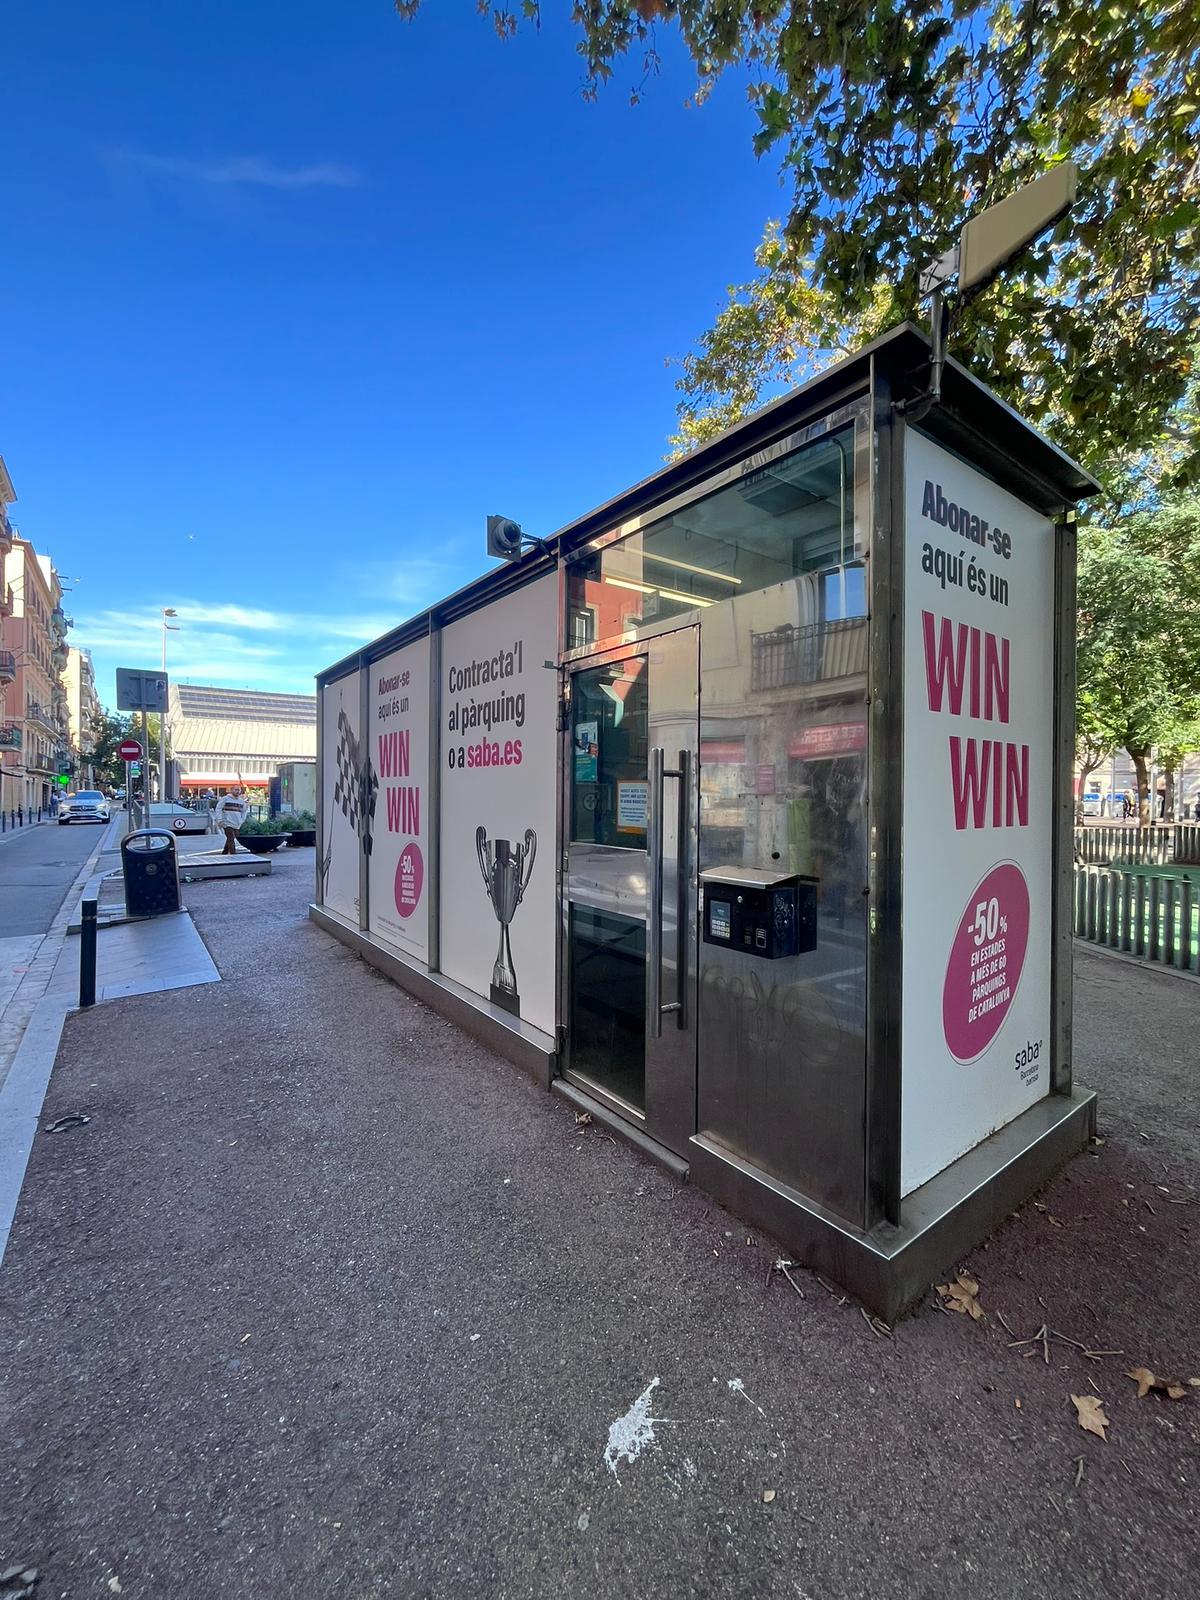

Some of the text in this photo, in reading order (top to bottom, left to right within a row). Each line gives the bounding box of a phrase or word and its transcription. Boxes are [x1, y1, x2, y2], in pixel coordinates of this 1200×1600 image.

[922, 479, 1012, 560] Abonar-se
[921, 542, 1009, 607] aquí és un
[378, 670, 410, 696] Abonar-se
[449, 639, 523, 694] Contracta'l
[921, 609, 1010, 724] WIN
[378, 696, 409, 722] aquí és un
[449, 690, 525, 736] al pàrquing
[379, 729, 410, 778] WIN
[448, 736, 523, 769] o a saba.es
[949, 735, 1030, 830] WIN
[386, 787, 420, 836] WIN
[967, 897, 1008, 946] -50%
[970, 938, 1006, 968] EN ESTADES
[970, 954, 1007, 986] A MÉS DE 60
[968, 986, 1011, 1024] DE CATALUNYA
[972, 972, 1007, 1003] PÀRQUINGS
